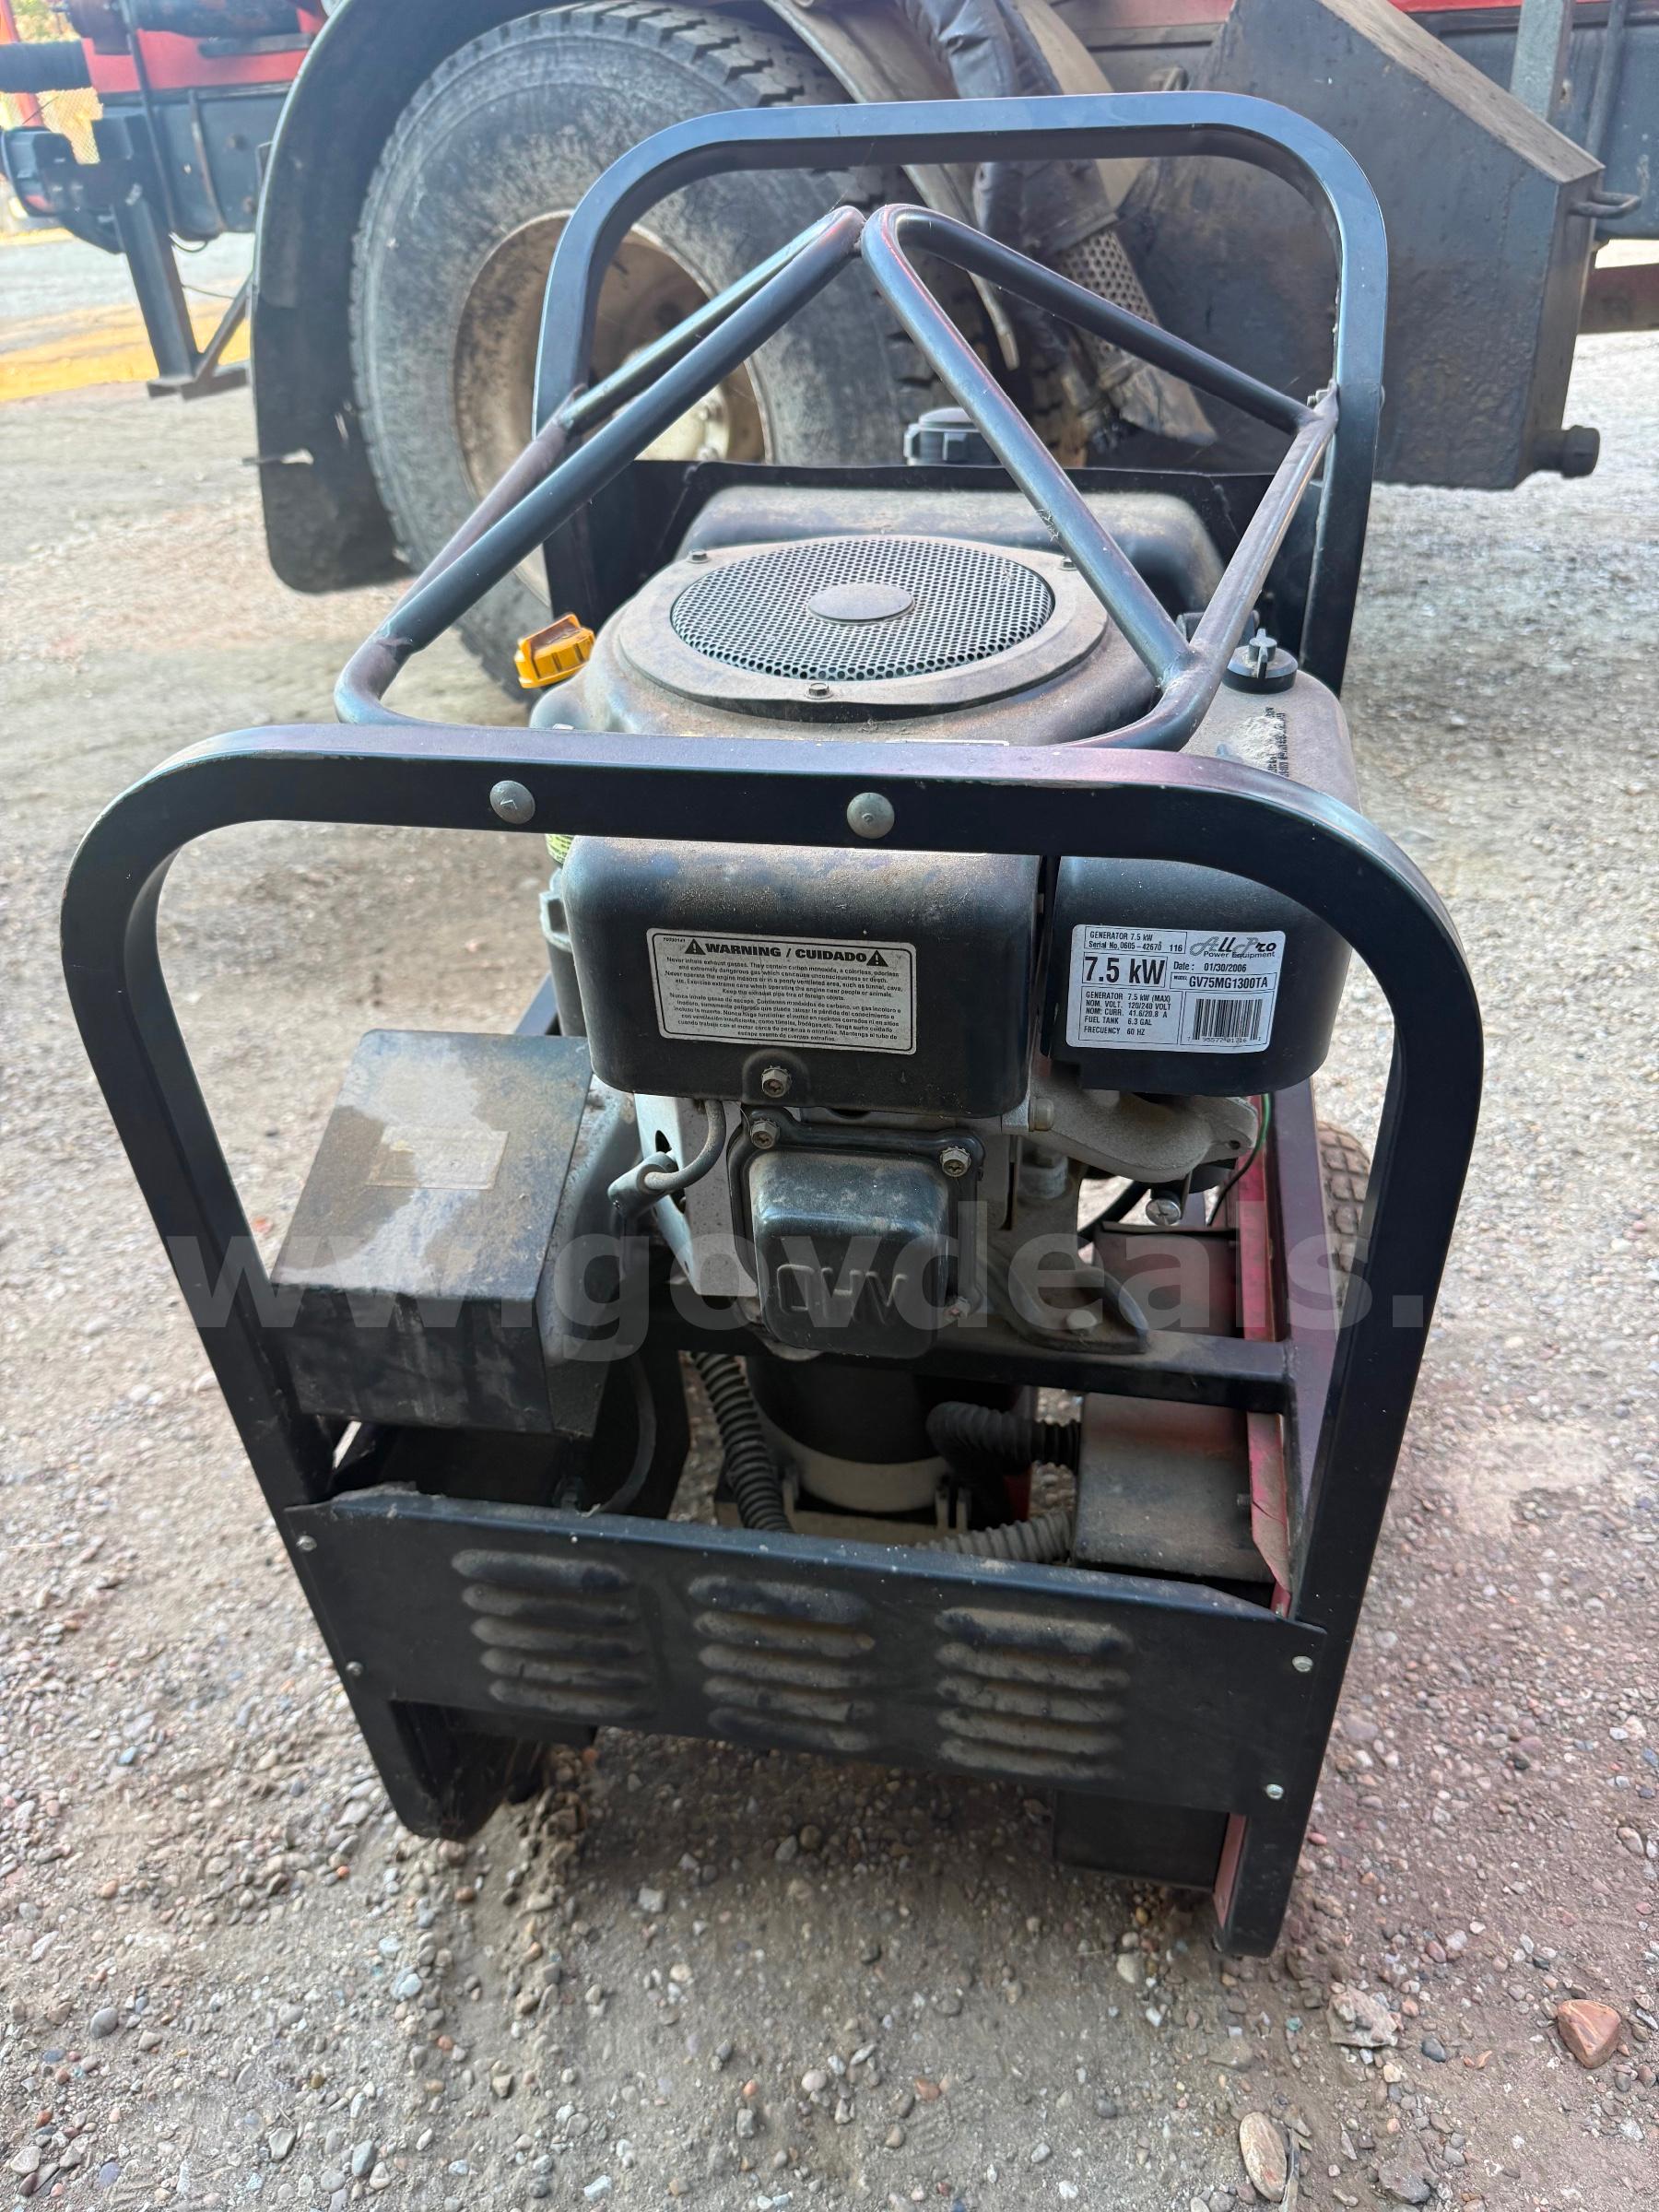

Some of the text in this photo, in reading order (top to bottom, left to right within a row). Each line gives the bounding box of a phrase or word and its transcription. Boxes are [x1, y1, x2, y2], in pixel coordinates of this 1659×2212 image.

[1089, 931, 1128, 940] GENERATOR
[1142, 934, 1153, 942] kW
[1088, 940, 1106, 948] Serial
[1169, 944, 1182, 952] 116
[704, 942, 866, 962] WARNING / CUIDADO
[1231, 951, 1275, 959] Equipment
[1085, 956, 1165, 984] 7.5 kW
[1173, 961, 1190, 971] Date
[1204, 962, 1247, 972] 01/30/2006
[1189, 975, 1268, 989] GV75MG1300TA
[1086, 991, 1124, 1000] GENERATOR
[1139, 994, 1150, 1002] kW
[1151, 994, 1171, 1003] (MAX)
[1128, 1002, 1153, 1010] 120/240
[1155, 1003, 1171, 1011] VOLT
[1104, 1008, 1124, 1017] CURR.
[1162, 1010, 1168, 1018] A
[1084, 1026, 1121, 1034] FRECUENCY
[777, 1265, 908, 1324] OHV
